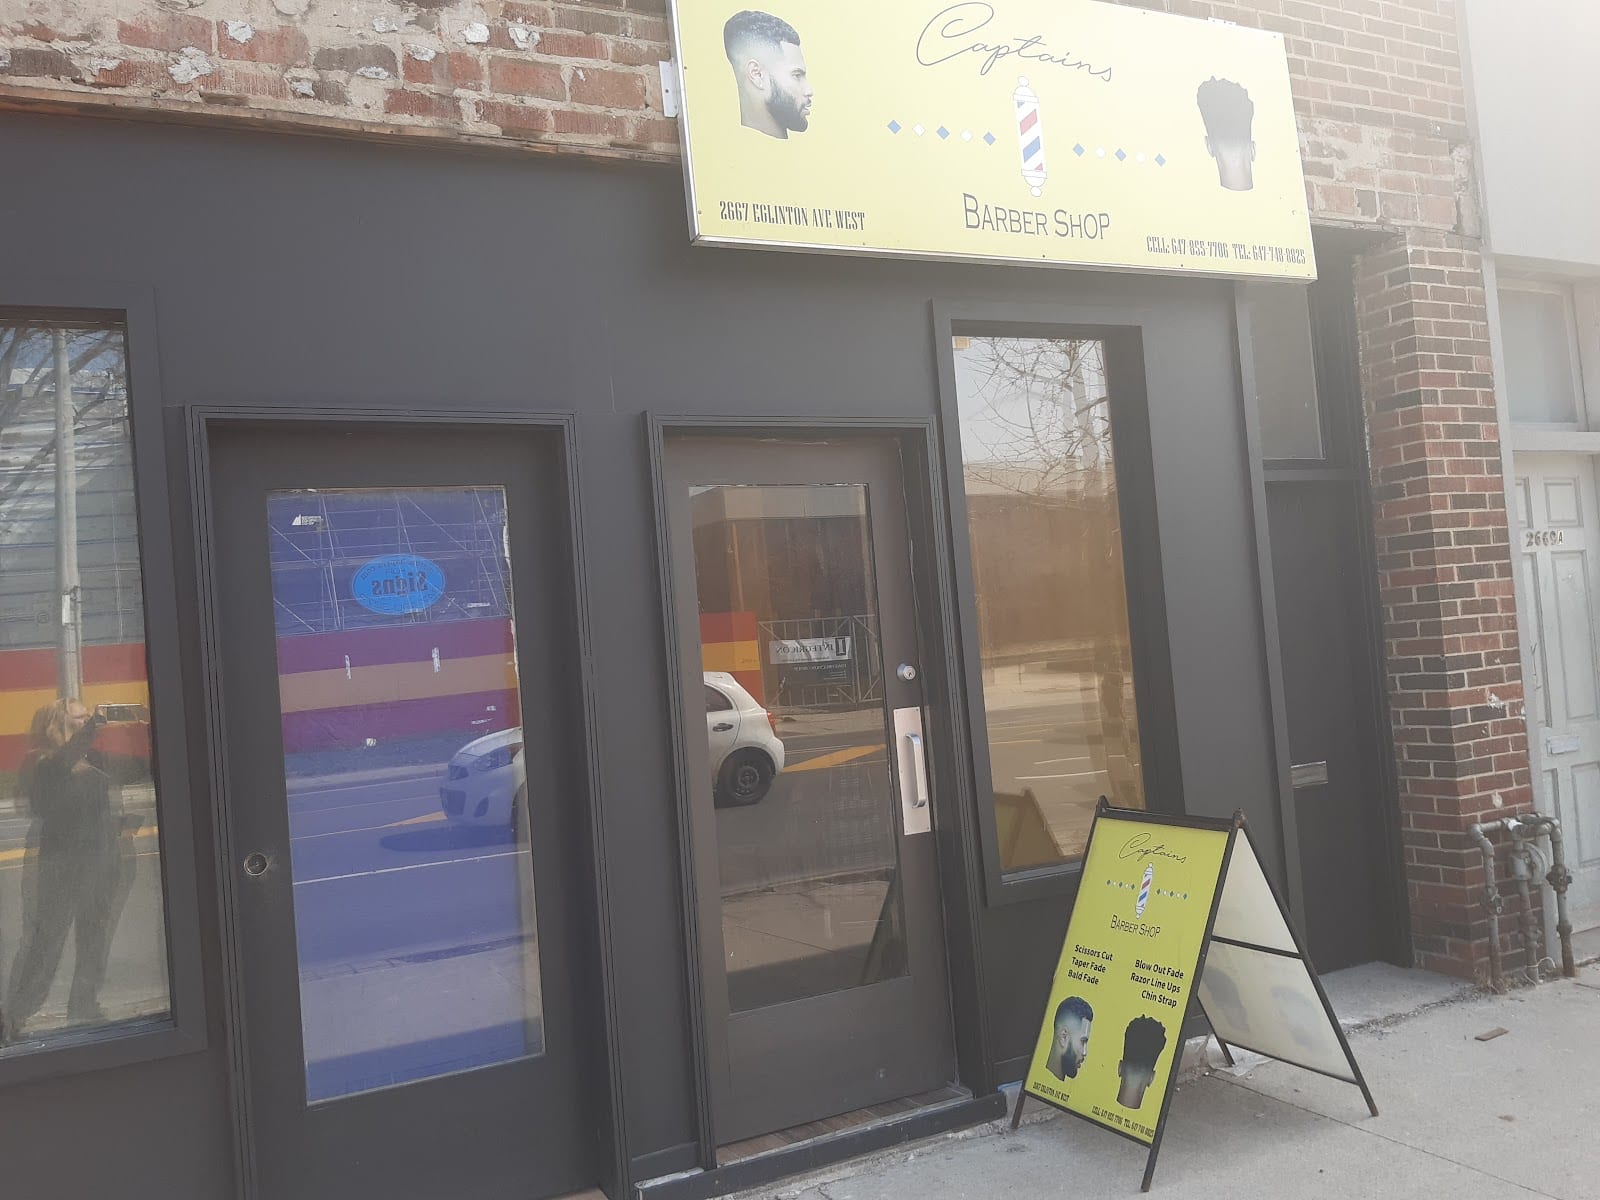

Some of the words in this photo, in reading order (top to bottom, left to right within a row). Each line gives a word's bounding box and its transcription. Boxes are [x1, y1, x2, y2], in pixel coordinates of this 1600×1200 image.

[917, 2, 1111, 81] Captains
[720, 201, 748, 222] 2667
[752, 204, 808, 226] EGLINTON
[812, 208, 832, 228] AVE
[835, 210, 865, 230] WEST
[963, 193, 1048, 236] BARBER
[1054, 209, 1110, 240] SHOP
[1146, 236, 1170, 254] CELL:
[1232, 243, 1251, 260] TEL:
[1526, 530, 1563, 547] 2669A
[1119, 833, 1187, 863] Captains
[1110, 914, 1139, 933] BARBER
[1139, 923, 1161, 938] SHOP
[1074, 944, 1100, 958] Scissors
[1101, 951, 1113, 961] Cut
[1072, 956, 1090, 969] Taper
[1090, 962, 1106, 973] Fade
[1134, 960, 1152, 971] Blow
[1152, 964, 1166, 974] Out
[1166, 967, 1184, 979] Fade
[1068, 970, 1082, 980] Bald
[1083, 974, 1099, 984] Fade
[1130, 972, 1150, 984] Razor
[1150, 978, 1166, 990] Line
[1166, 982, 1181, 993] Ups
[1141, 990, 1157, 1001] Chin
[1157, 994, 1177, 1008] Strap
